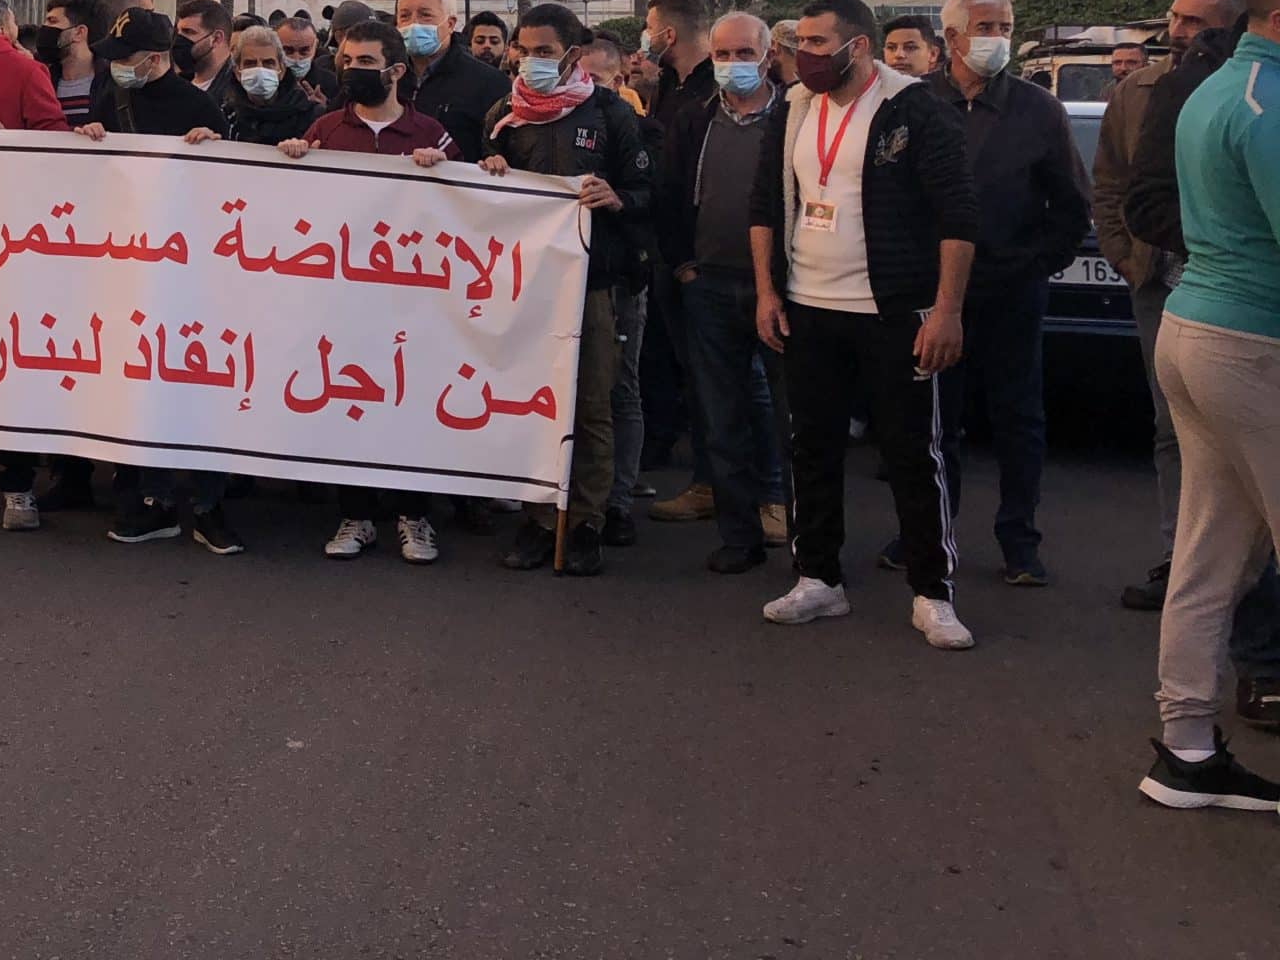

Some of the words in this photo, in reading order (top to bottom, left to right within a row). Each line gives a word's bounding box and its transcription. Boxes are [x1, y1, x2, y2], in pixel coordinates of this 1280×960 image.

[213, 198, 523, 319] الإنتفاضة
[121, 309, 255, 412] إنقاذ
[283, 330, 406, 422] أجل
[435, 363, 559, 431] من
